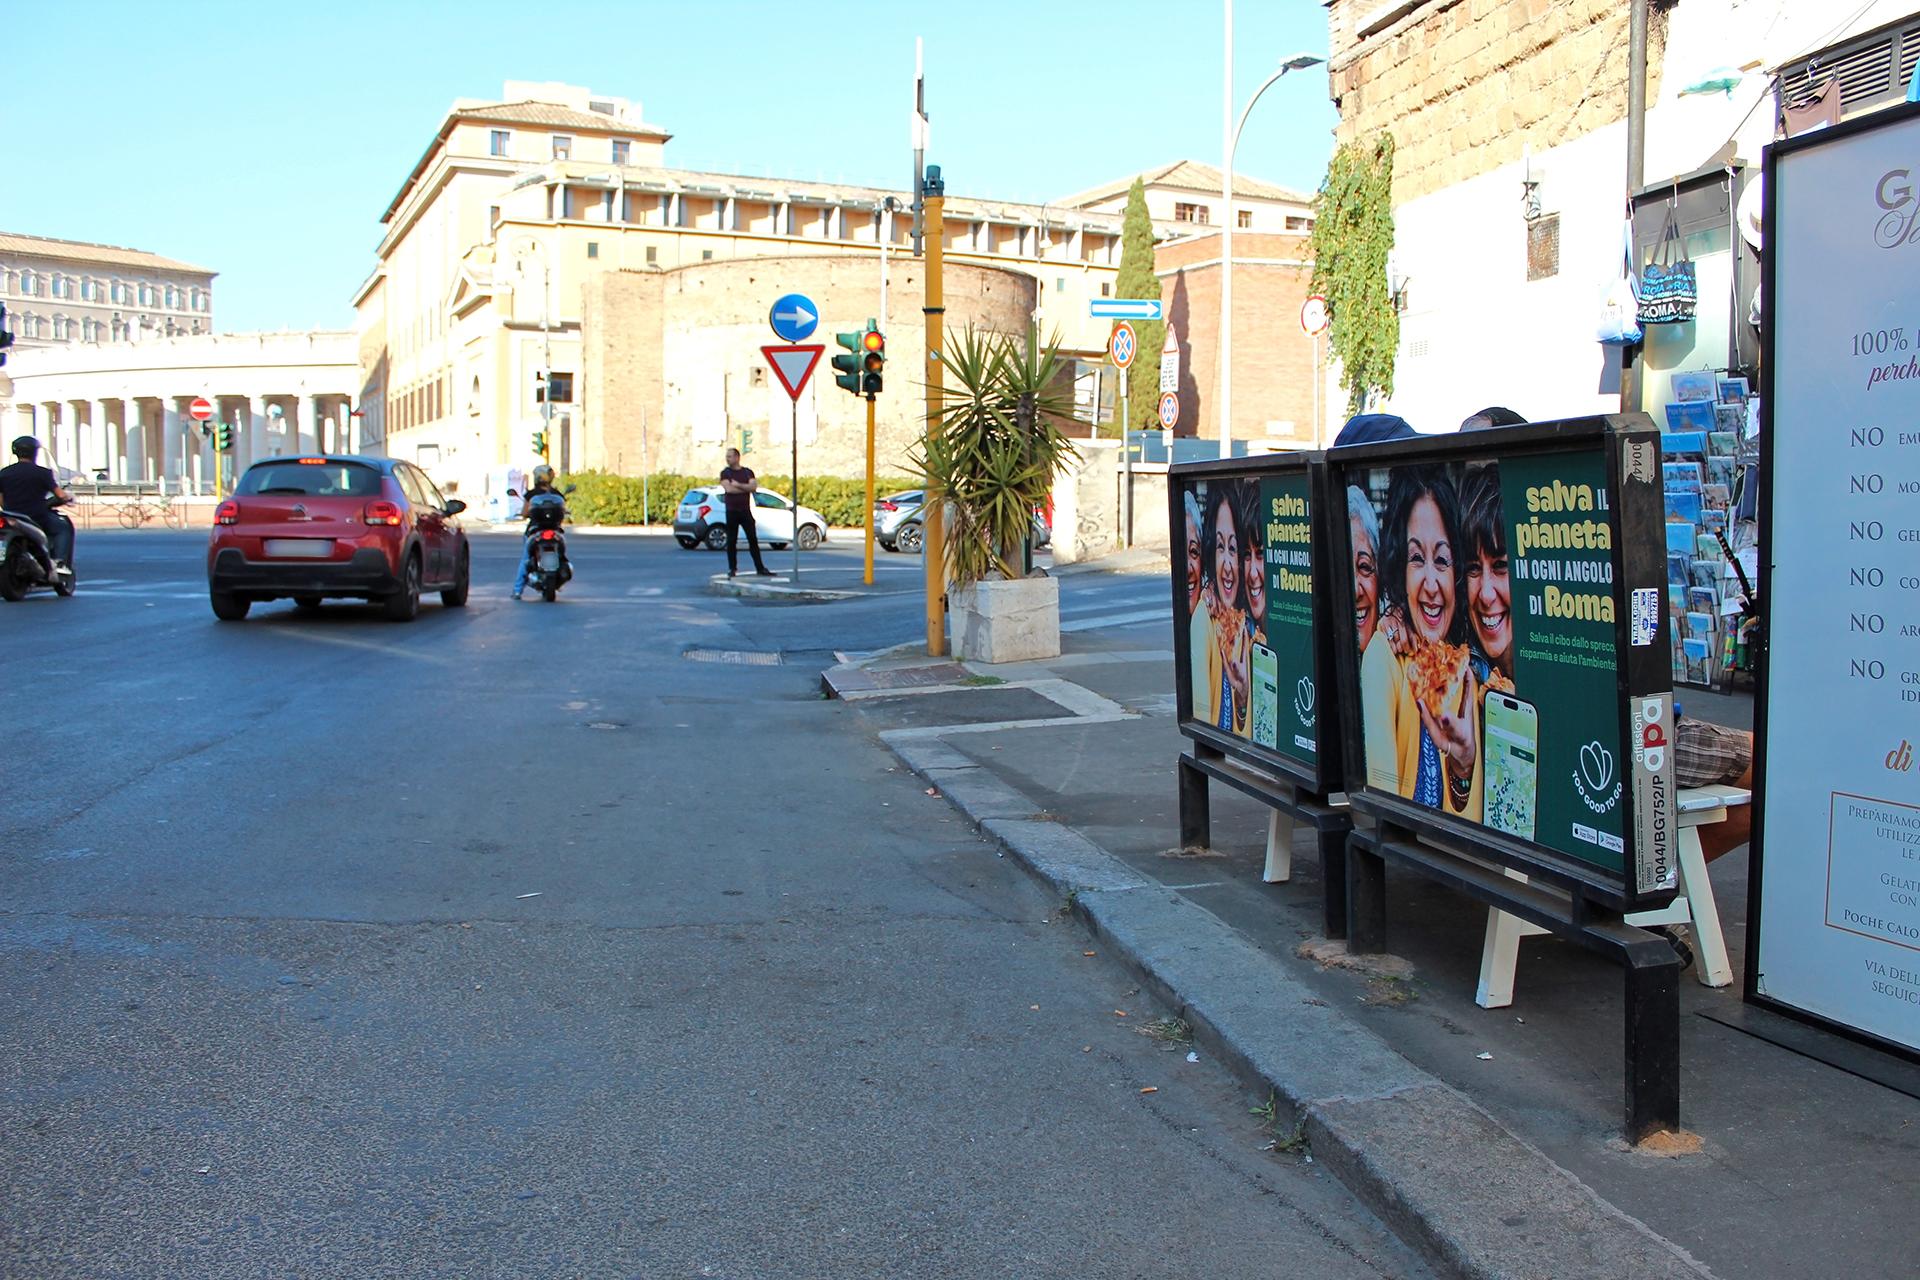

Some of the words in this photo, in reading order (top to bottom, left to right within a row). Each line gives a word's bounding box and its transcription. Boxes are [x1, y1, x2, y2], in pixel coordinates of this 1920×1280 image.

[1851, 328, 1908, 356] 100%
[1851, 427, 1884, 447] NO
[1850, 474, 1883, 494] NO
[1272, 494, 1305, 517] salva
[1526, 479, 1593, 512] salva
[1597, 489, 1609, 510] IL
[1515, 516, 1611, 557] pianeta
[1850, 521, 1883, 541] NO
[1266, 549, 1274, 563] IN
[1274, 549, 1289, 565] OGNI
[1290, 550, 1311, 567] ANGOL
[1272, 574, 1279, 589] DI
[1515, 559, 1529, 579] IN
[1531, 559, 1562, 581] OGNI
[1564, 560, 1613, 584] ANGOLO
[1850, 567, 1884, 587] NO
[1529, 595, 1542, 615] DI
[1544, 585, 1615, 623] Roma
[1850, 613, 1884, 634] NO
[1900, 625, 1920, 637] AR
[1529, 631, 1549, 644] Salva
[1550, 633, 1554, 644] il
[1555, 635, 1570, 646] cibo
[1572, 636, 1589, 649] dallo
[1520, 647, 1553, 661] risparmia
[1554, 653, 1558, 662] e
[1559, 652, 1578, 665] aiuta
[1850, 658, 1885, 679] NO
[1633, 711, 1644, 763] affissioni
[1642, 698, 1667, 772] apa
[1884, 739, 1914, 772] di
[1571, 770, 1584, 796] TOO
[1584, 795, 1605, 814] GOOD
[1605, 797, 1615, 811] TO
[1613, 782, 1622, 799] GO
[1653, 774, 1667, 884] 0044/BG752/P
[1902, 847, 1914, 860] LE
[1890, 892, 1917, 908] CON
[1844, 909, 1883, 930] POCHE
[1865, 959, 1886, 977] VIA
[1872, 980, 1920, 1006] SEGUIC
